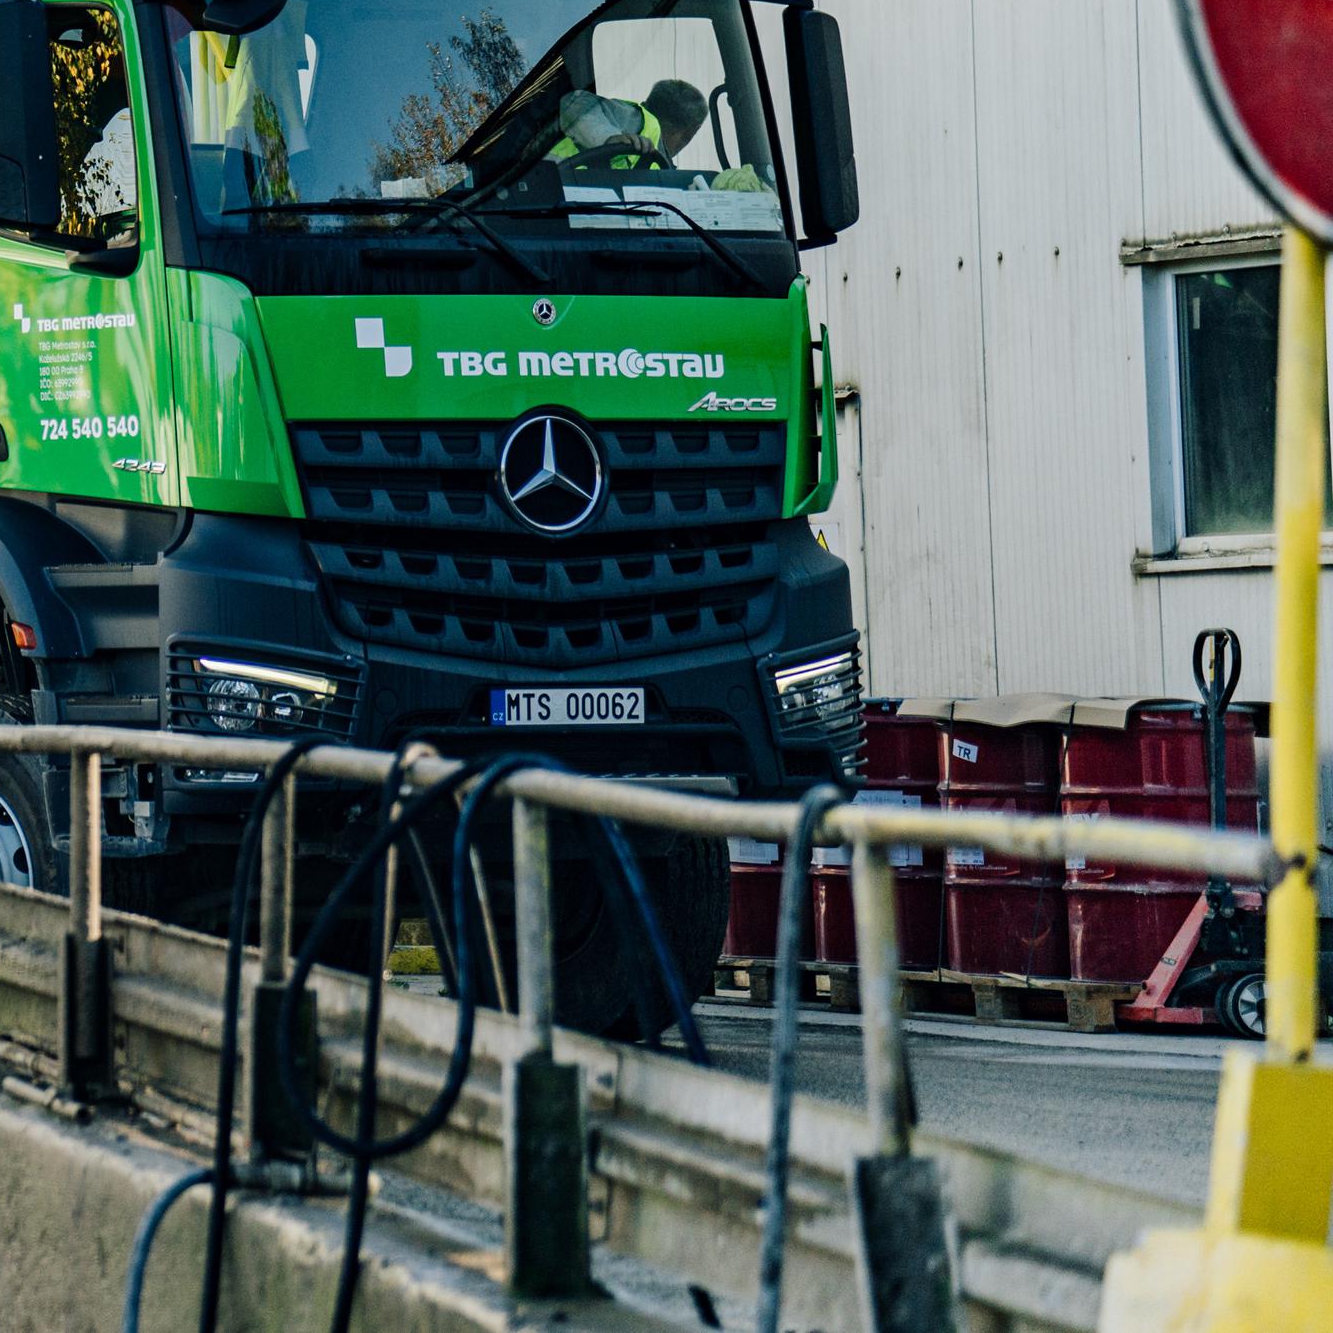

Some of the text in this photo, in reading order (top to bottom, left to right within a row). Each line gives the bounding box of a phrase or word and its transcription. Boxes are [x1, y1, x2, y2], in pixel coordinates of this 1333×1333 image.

[37, 319, 60, 332] TBG
[38, 341, 51, 351] TBG
[436, 350, 507, 376] TBG
[40, 414, 139, 441] 724 540 540
[506, 692, 640, 721] MTS 00062
[492, 712, 503, 721] CZ
[957, 745, 971, 760] TR
